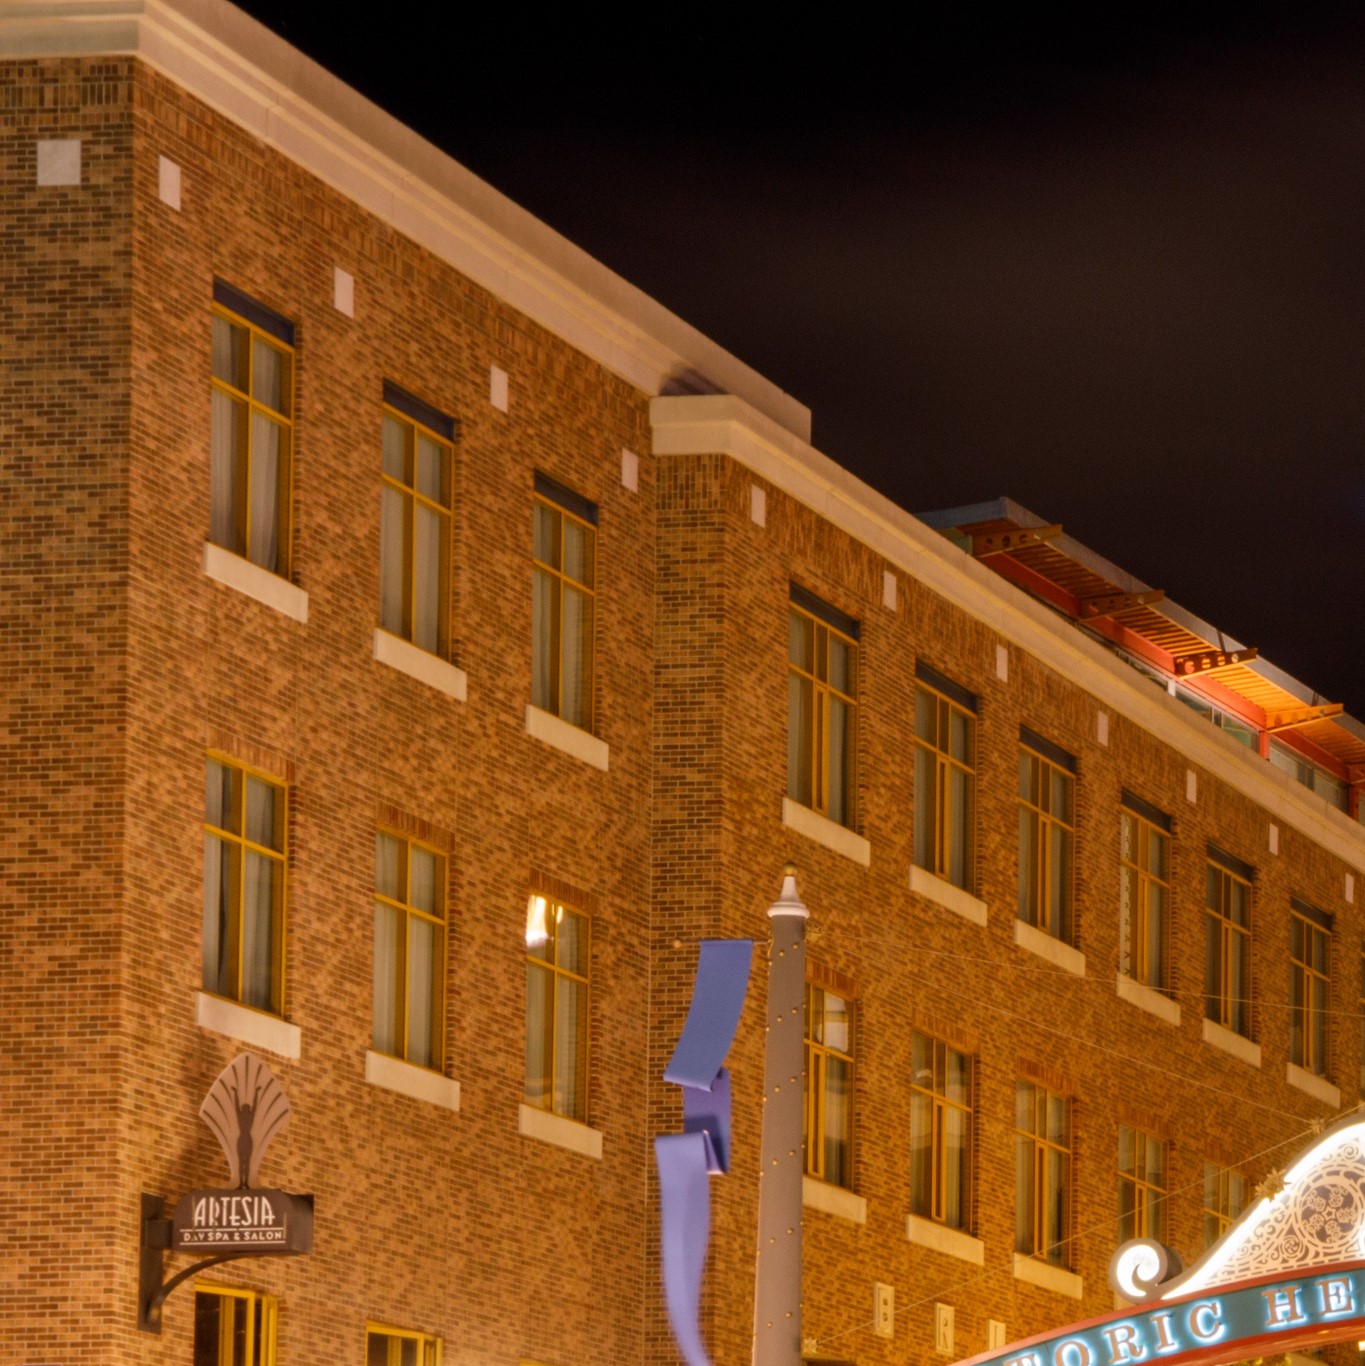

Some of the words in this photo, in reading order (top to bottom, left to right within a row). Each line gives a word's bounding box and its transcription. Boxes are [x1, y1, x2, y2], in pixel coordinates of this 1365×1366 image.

[194, 1196, 275, 1226] ARTESIA
[184, 1233, 204, 1242] DAY
[208, 1232, 229, 1241] SPA
[234, 1232, 241, 1240] &
[244, 1231, 282, 1240] SALON
